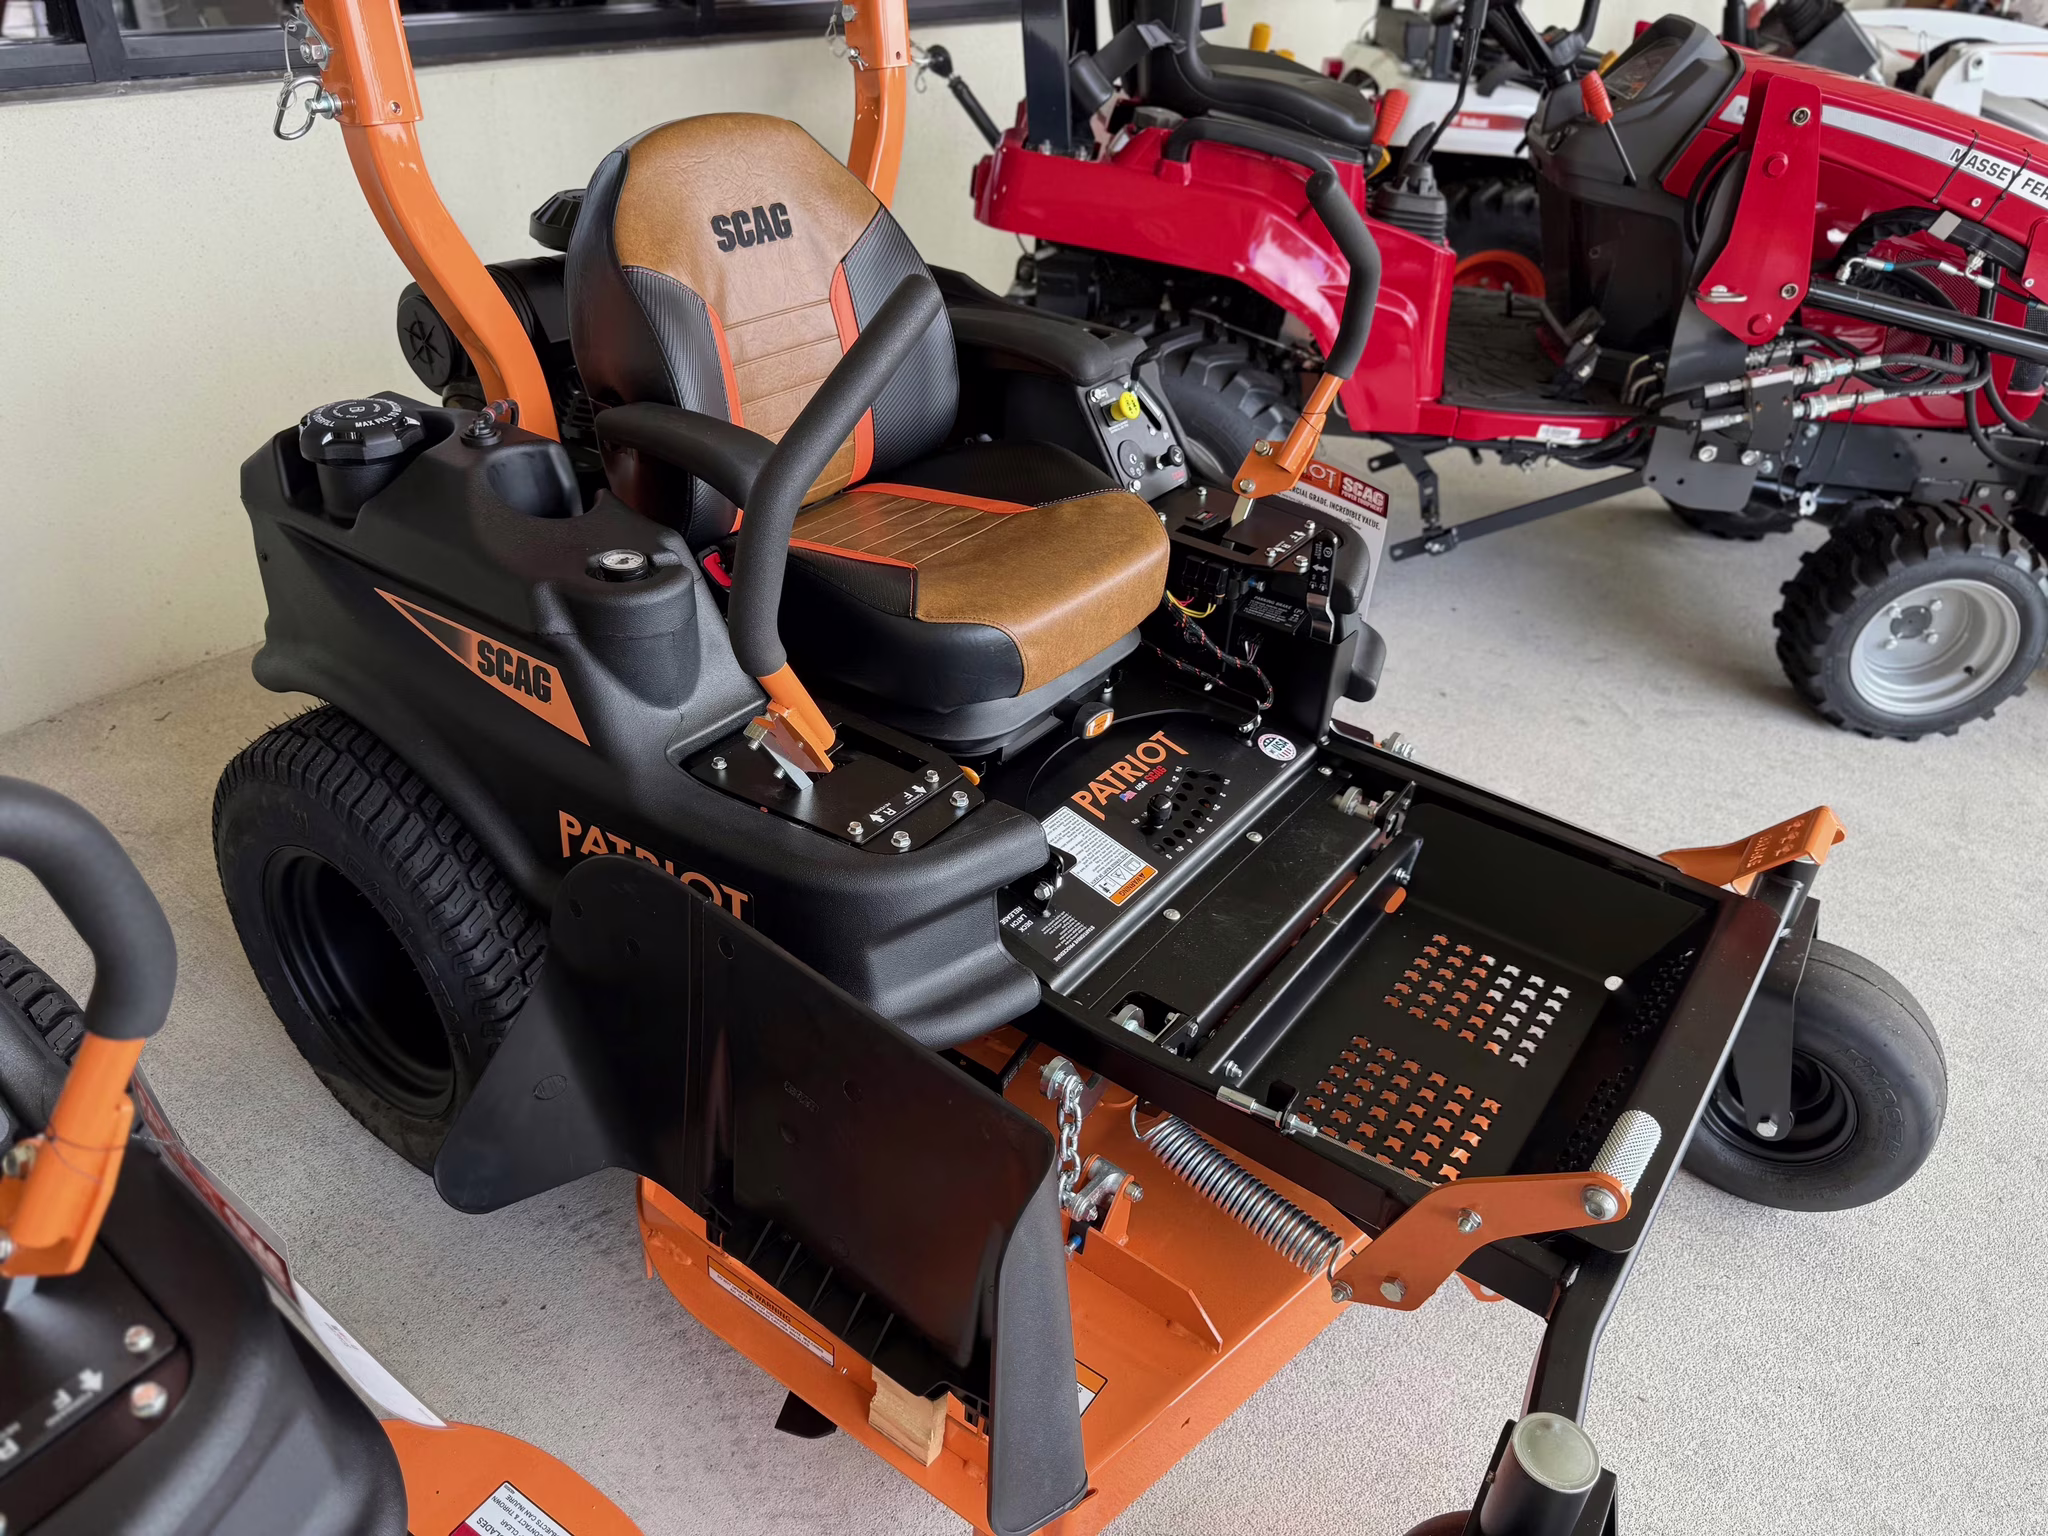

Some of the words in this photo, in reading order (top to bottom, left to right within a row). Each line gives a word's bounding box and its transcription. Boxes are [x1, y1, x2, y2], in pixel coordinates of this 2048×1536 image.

[1949, 148, 2021, 187] MASSEY
[711, 202, 793, 253] SCAG
[355, 420, 375, 428] MAX
[1342, 476, 1385, 507] SCAG
[1329, 499, 1362, 522] INCREDIBLE
[477, 639, 553, 706] SCAG
[1271, 738, 1289, 752] USA
[1071, 730, 1190, 821] PATRIOT
[1135, 780, 1148, 791] USA
[1144, 765, 1168, 784] SCAG
[883, 808, 897, 816] R
[1117, 875, 1142, 897] WARNING
[1000, 905, 1023, 926] RELEASE
[1010, 913, 1028, 928] LATCH
[1018, 920, 1034, 933] DECK
[752, 1291, 791, 1323] WARNING
[491, 1495, 514, 1517] THROWN
[505, 1494, 527, 1512] INJURE
[525, 1509, 537, 1522] CAN
[500, 1518, 520, 1536] CLEAR
[535, 1519, 565, 1536] BJECTS
